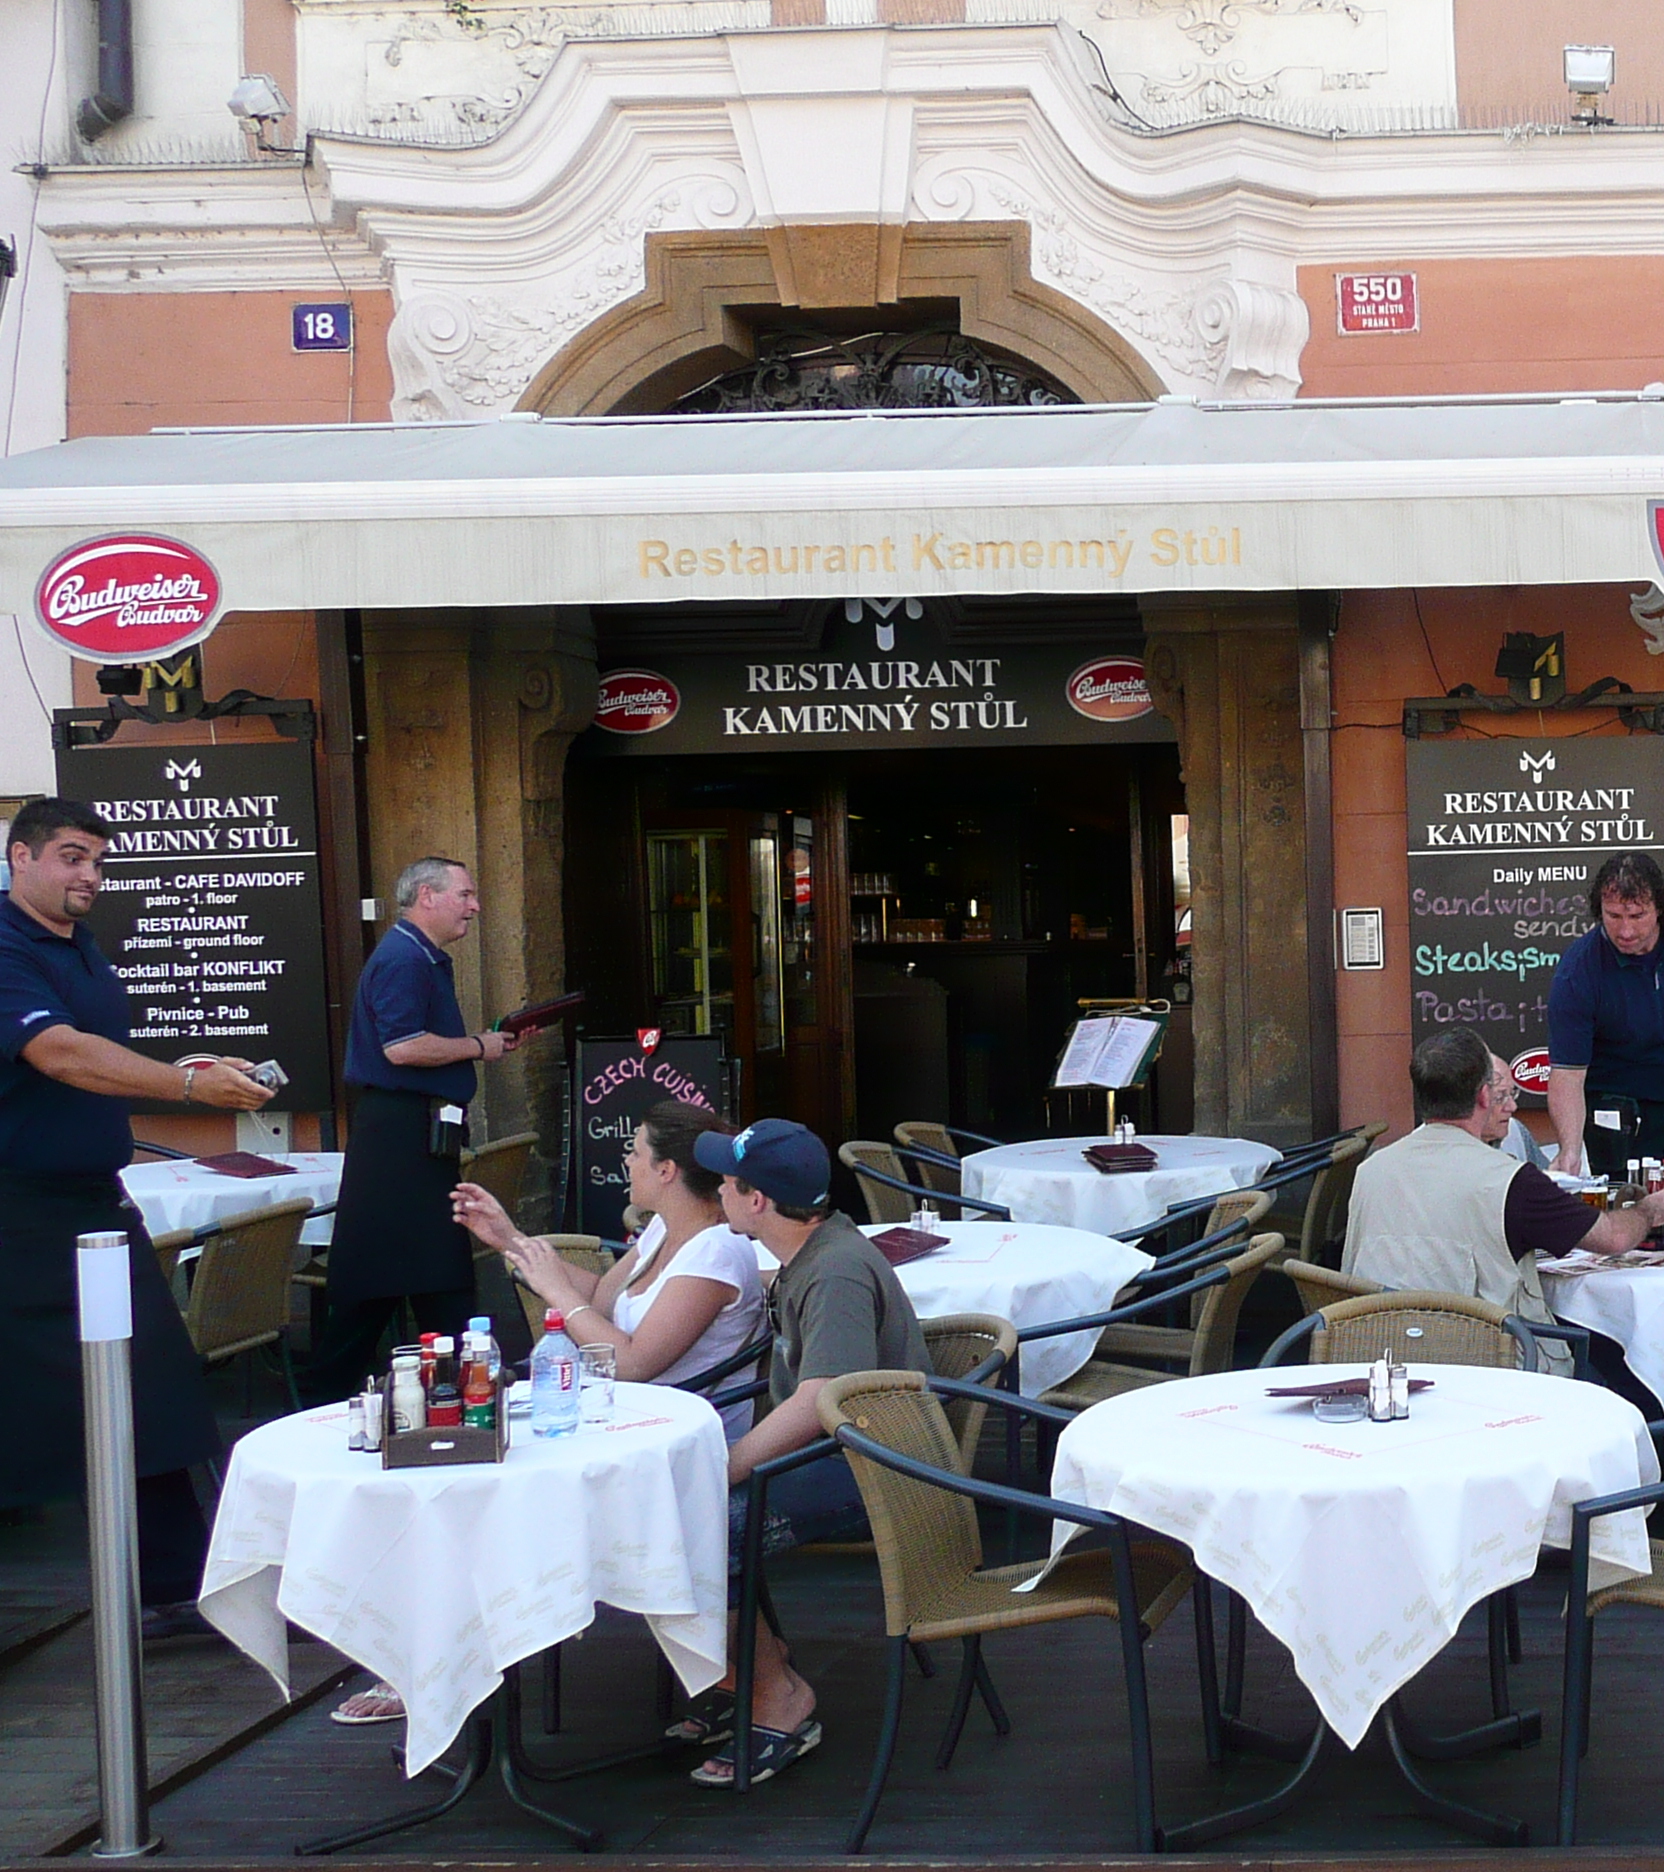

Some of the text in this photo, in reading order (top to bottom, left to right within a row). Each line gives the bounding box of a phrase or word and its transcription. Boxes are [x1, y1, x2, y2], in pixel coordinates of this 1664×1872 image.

[1353, 277, 1402, 302] 550
[303, 312, 334, 339] 18
[1362, 317, 1396, 328] PRAHA 1
[638, 526, 1241, 578] Restaurant Kamenný Stůl
[50, 573, 208, 620] Budweiser
[116, 601, 204, 628] Budvar
[746, 659, 1000, 693] RESTAURANT
[722, 692, 1028, 735] KAMENNÝ STŮL
[94, 795, 279, 823] RESTAURANT
[1444, 788, 1635, 815] RESTAURANT
[105, 820, 299, 854] AMENNÝ STŮL
[1426, 813, 1655, 847] KAMENNÝ STŮL
[174, 873, 220, 889] CAFE
[223, 871, 306, 888] DAVIDOFF
[1493, 865, 1588, 886] Daily MENU
[145, 893, 181, 908] patro
[190, 892, 205, 906] 1.
[206, 891, 239, 904] floor
[1413, 887, 1590, 917] Sandwiches
[137, 914, 249, 932] RESTAURANT
[183, 934, 231, 950] ground
[233, 932, 265, 947] floor
[173, 961, 200, 977] bar
[202, 960, 286, 977] KONFLIKT
[126, 980, 177, 995] suterén
[187, 980, 201, 993] 1.
[202, 978, 267, 993] basement
[147, 1006, 205, 1022] Pivnice
[218, 1005, 250, 1020] Pub
[1416, 987, 1514, 1022] Pasta
[129, 1024, 179, 1039] suterén
[189, 1024, 203, 1037] 2.
[204, 1022, 269, 1037] basement
[584, 1056, 646, 1104] CZECH
